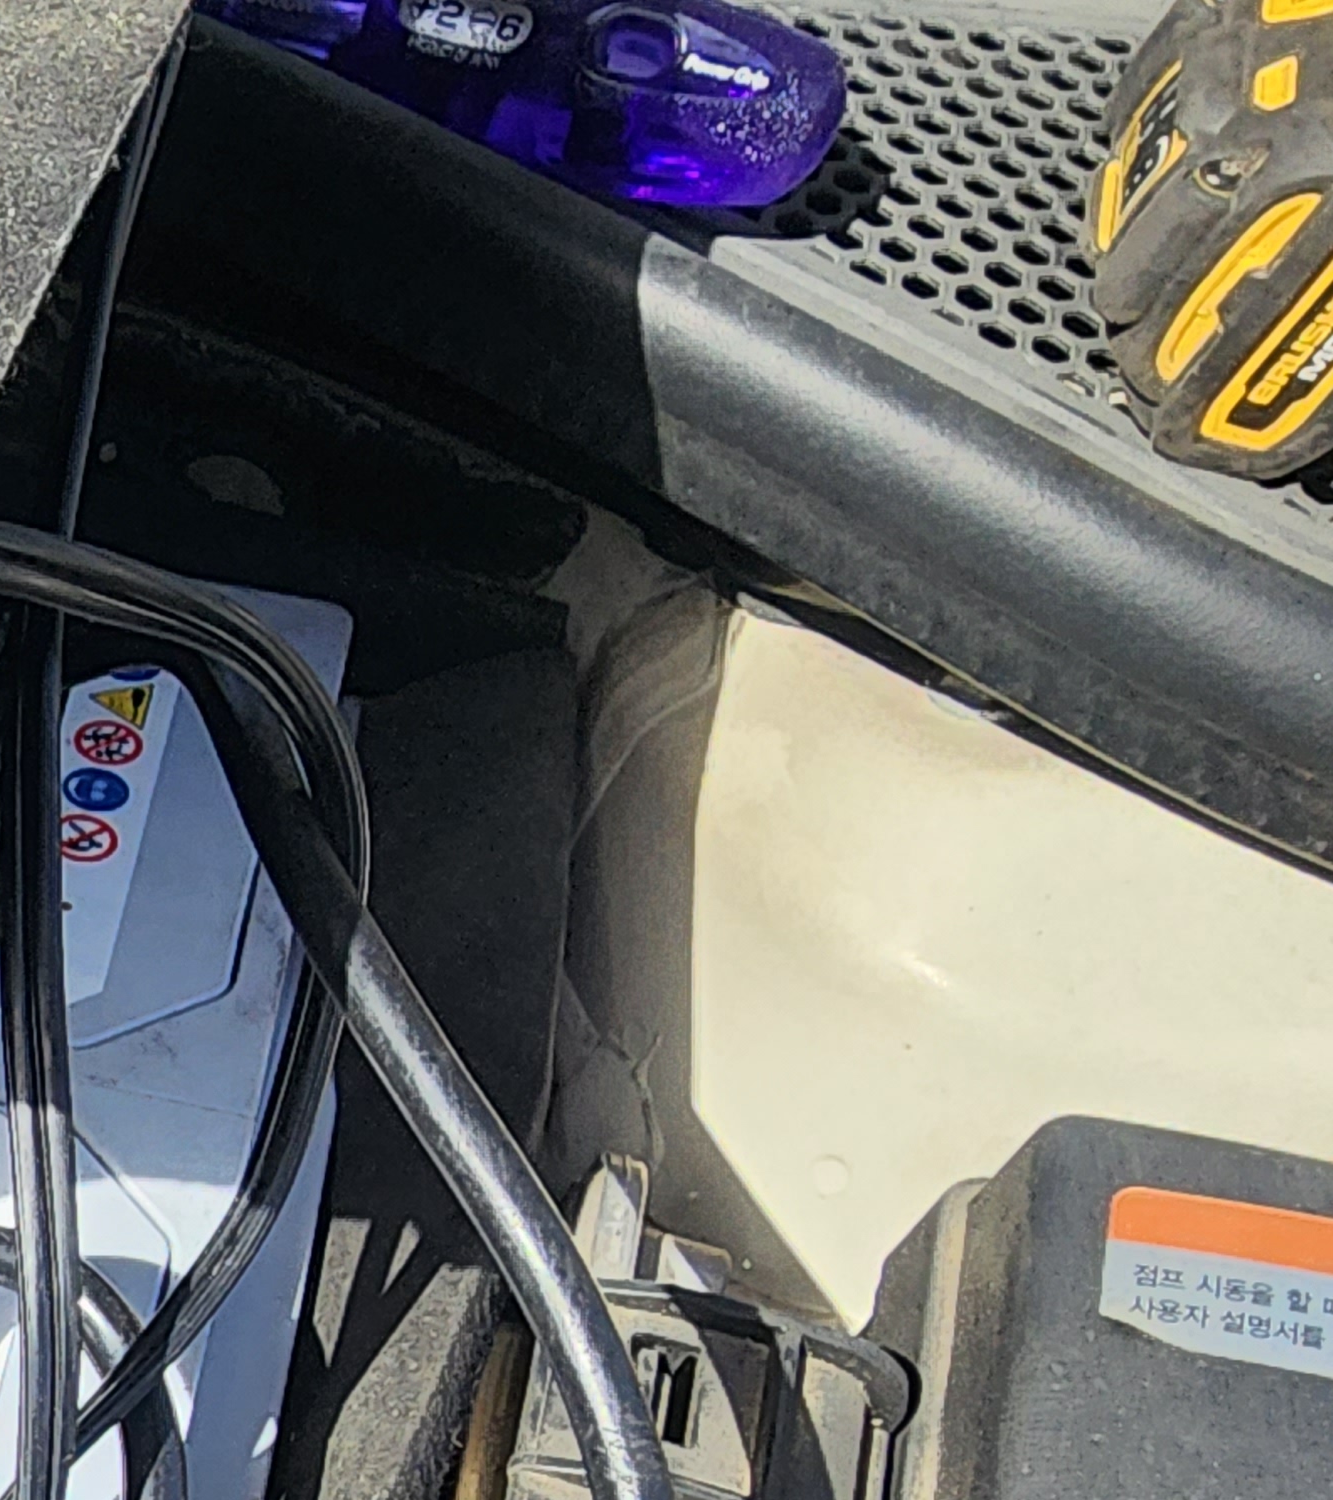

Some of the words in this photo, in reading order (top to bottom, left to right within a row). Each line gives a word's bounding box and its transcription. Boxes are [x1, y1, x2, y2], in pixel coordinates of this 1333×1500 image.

[1133, 1263, 1186, 1290] 점프
[1196, 1274, 1275, 1307] 시동을
[1128, 1295, 1211, 1329] 사용자
[1219, 1310, 1326, 1350] 설명서를
